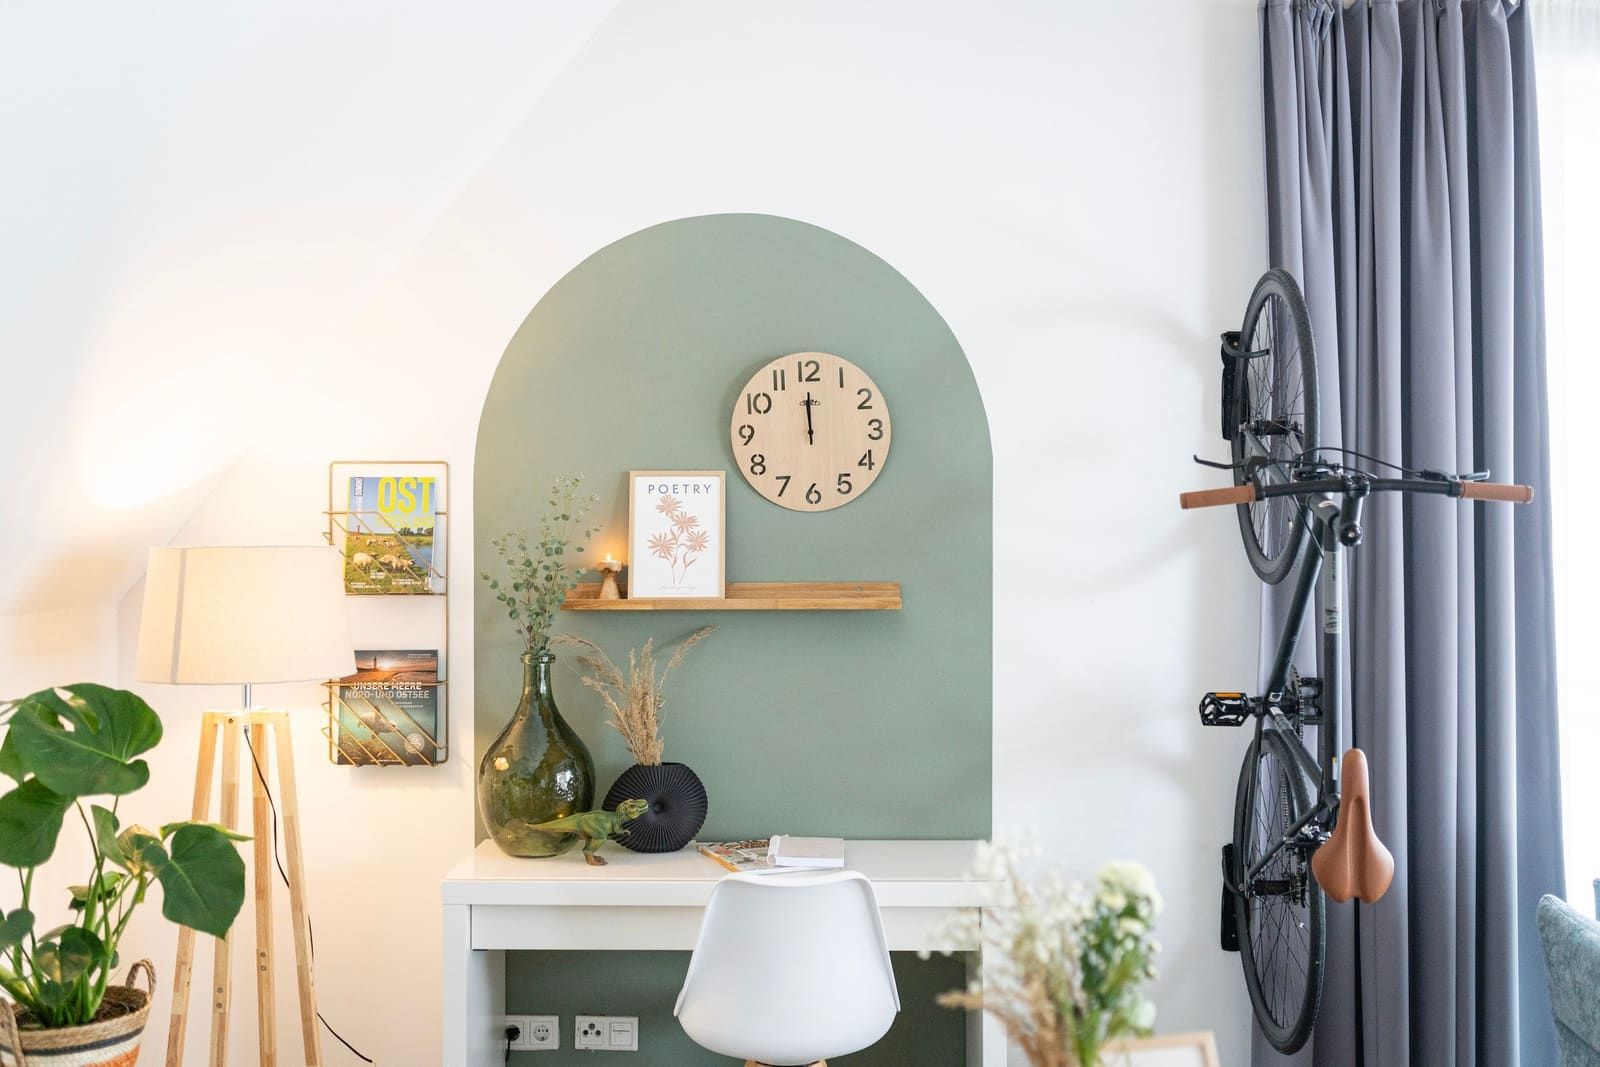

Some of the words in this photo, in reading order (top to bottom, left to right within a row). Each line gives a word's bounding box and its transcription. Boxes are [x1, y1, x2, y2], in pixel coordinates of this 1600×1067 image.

[773, 369, 786, 391] 11
[798, 360, 821, 383] 12
[747, 392, 772, 415] 10
[856, 388, 873, 410] 2
[738, 424, 755, 446] 9
[867, 418, 884, 440] 3
[750, 453, 766, 475] 8
[857, 449, 875, 470] 4
[648, 484, 712, 495] POETRY
[775, 475, 791, 497] 7
[805, 483, 822, 504] 6
[837, 473, 853, 494] 5
[378, 477, 435, 513] OST
[353, 681, 389, 690] UNSERE
[391, 681, 422, 690] MEERE
[395, 690, 430, 699] OSTSEE
